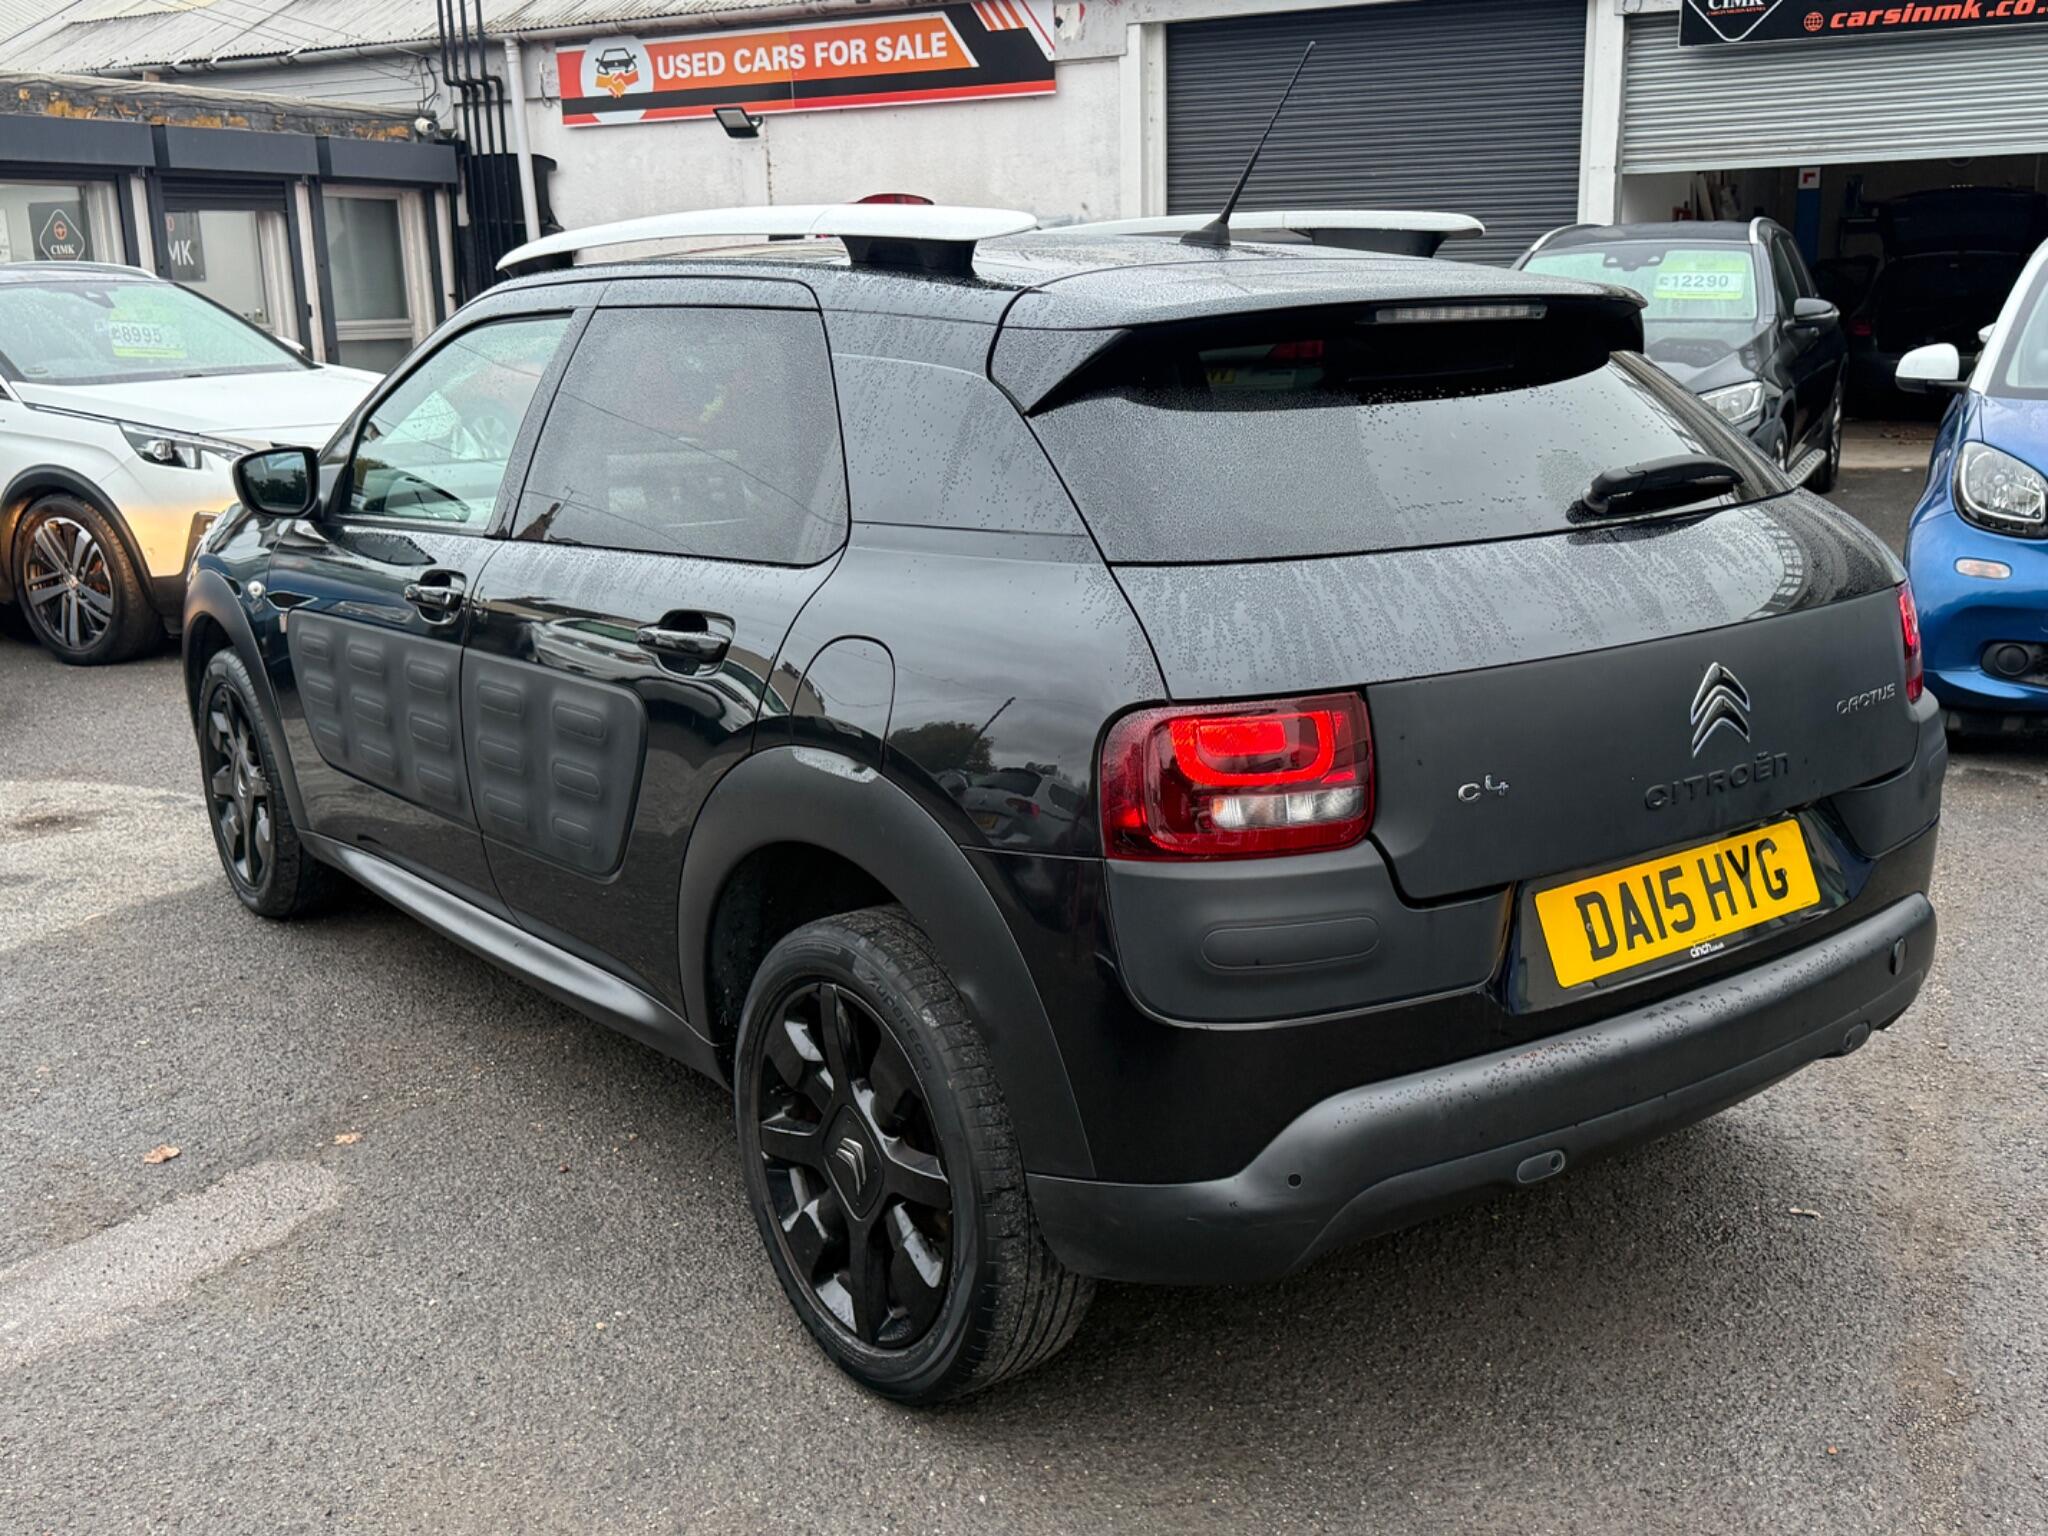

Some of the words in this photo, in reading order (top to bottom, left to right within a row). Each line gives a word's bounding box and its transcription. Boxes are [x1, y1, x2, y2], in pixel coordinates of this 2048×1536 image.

[1830, 0, 2048, 29] carsinmk.co.
[657, 51, 726, 80] USED
[733, 44, 806, 74] CARS
[814, 37, 868, 68] FOR
[875, 31, 948, 62] SALE
[1836, 682, 1896, 716] CACTUS
[1458, 774, 1509, 802] C4
[1574, 865, 1696, 962] DA15
[1696, 838, 1789, 922] HYG
